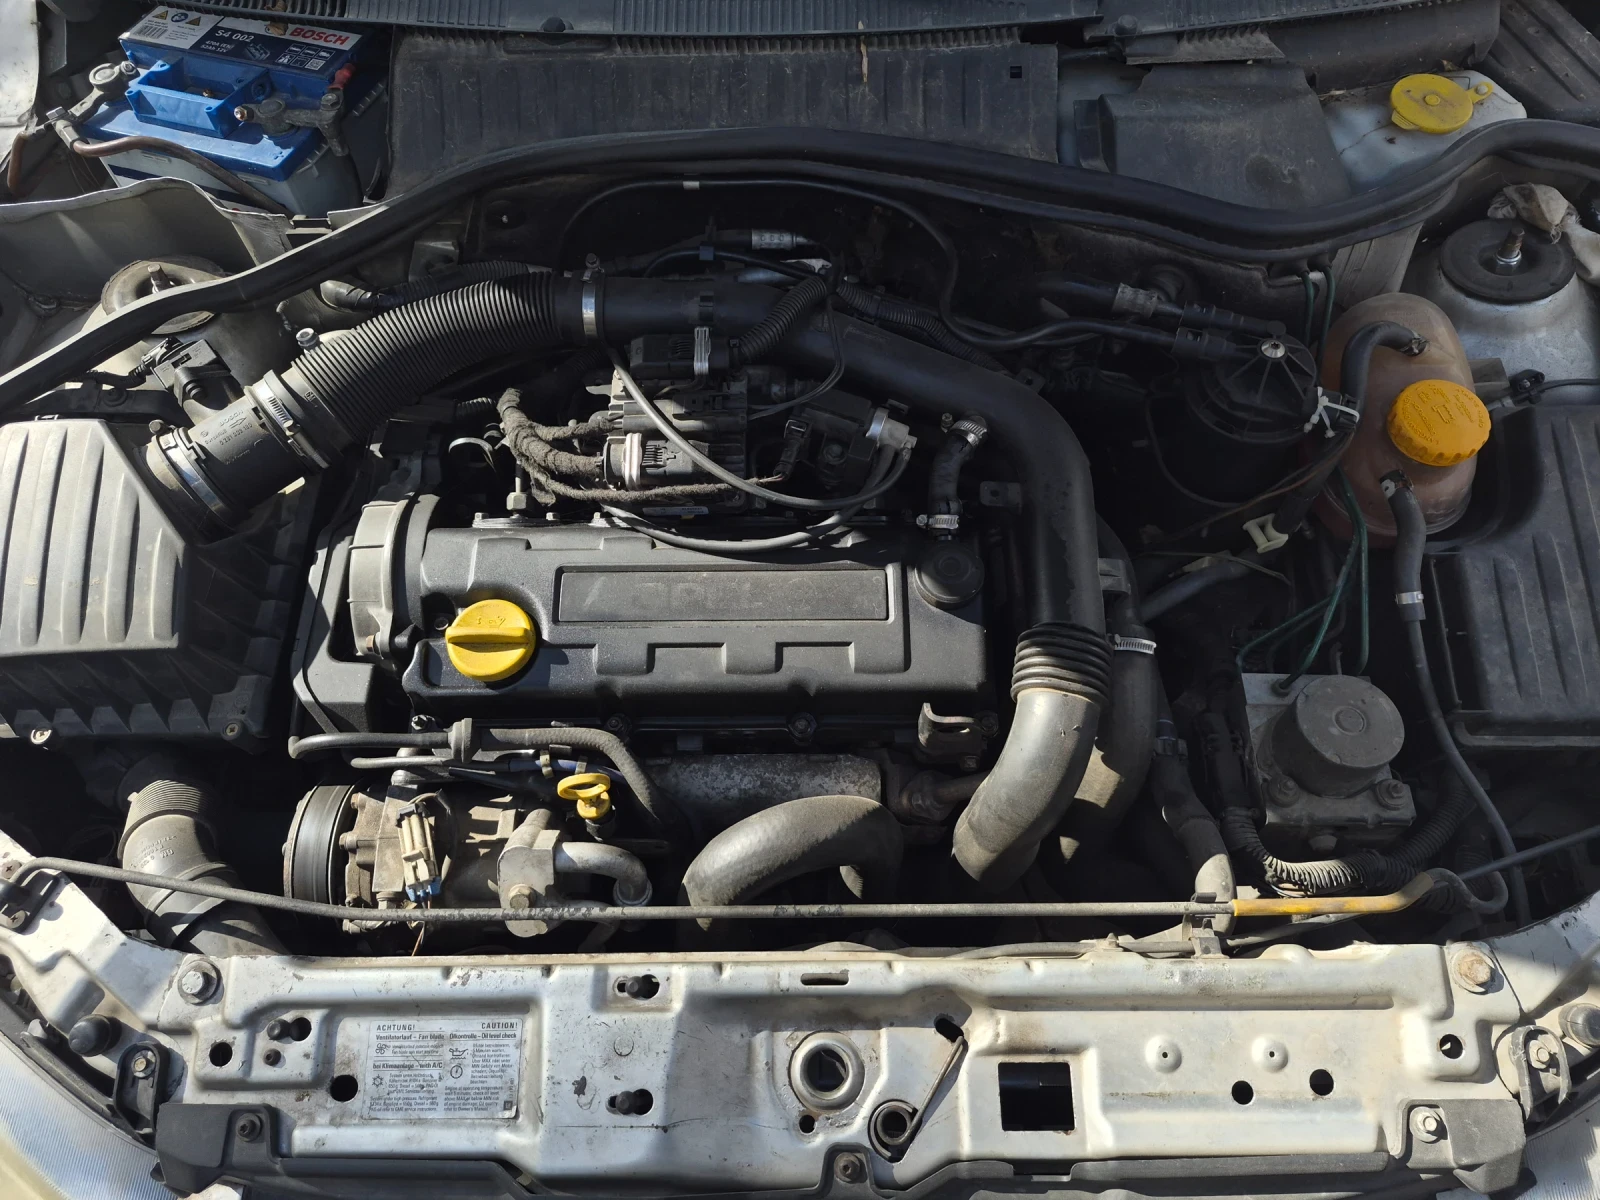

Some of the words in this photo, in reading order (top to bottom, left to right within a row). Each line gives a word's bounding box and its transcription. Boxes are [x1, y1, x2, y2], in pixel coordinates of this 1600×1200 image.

[215, 29, 230, 38] S4
[232, 33, 255, 42] 002
[289, 27, 350, 46] BOSCH
